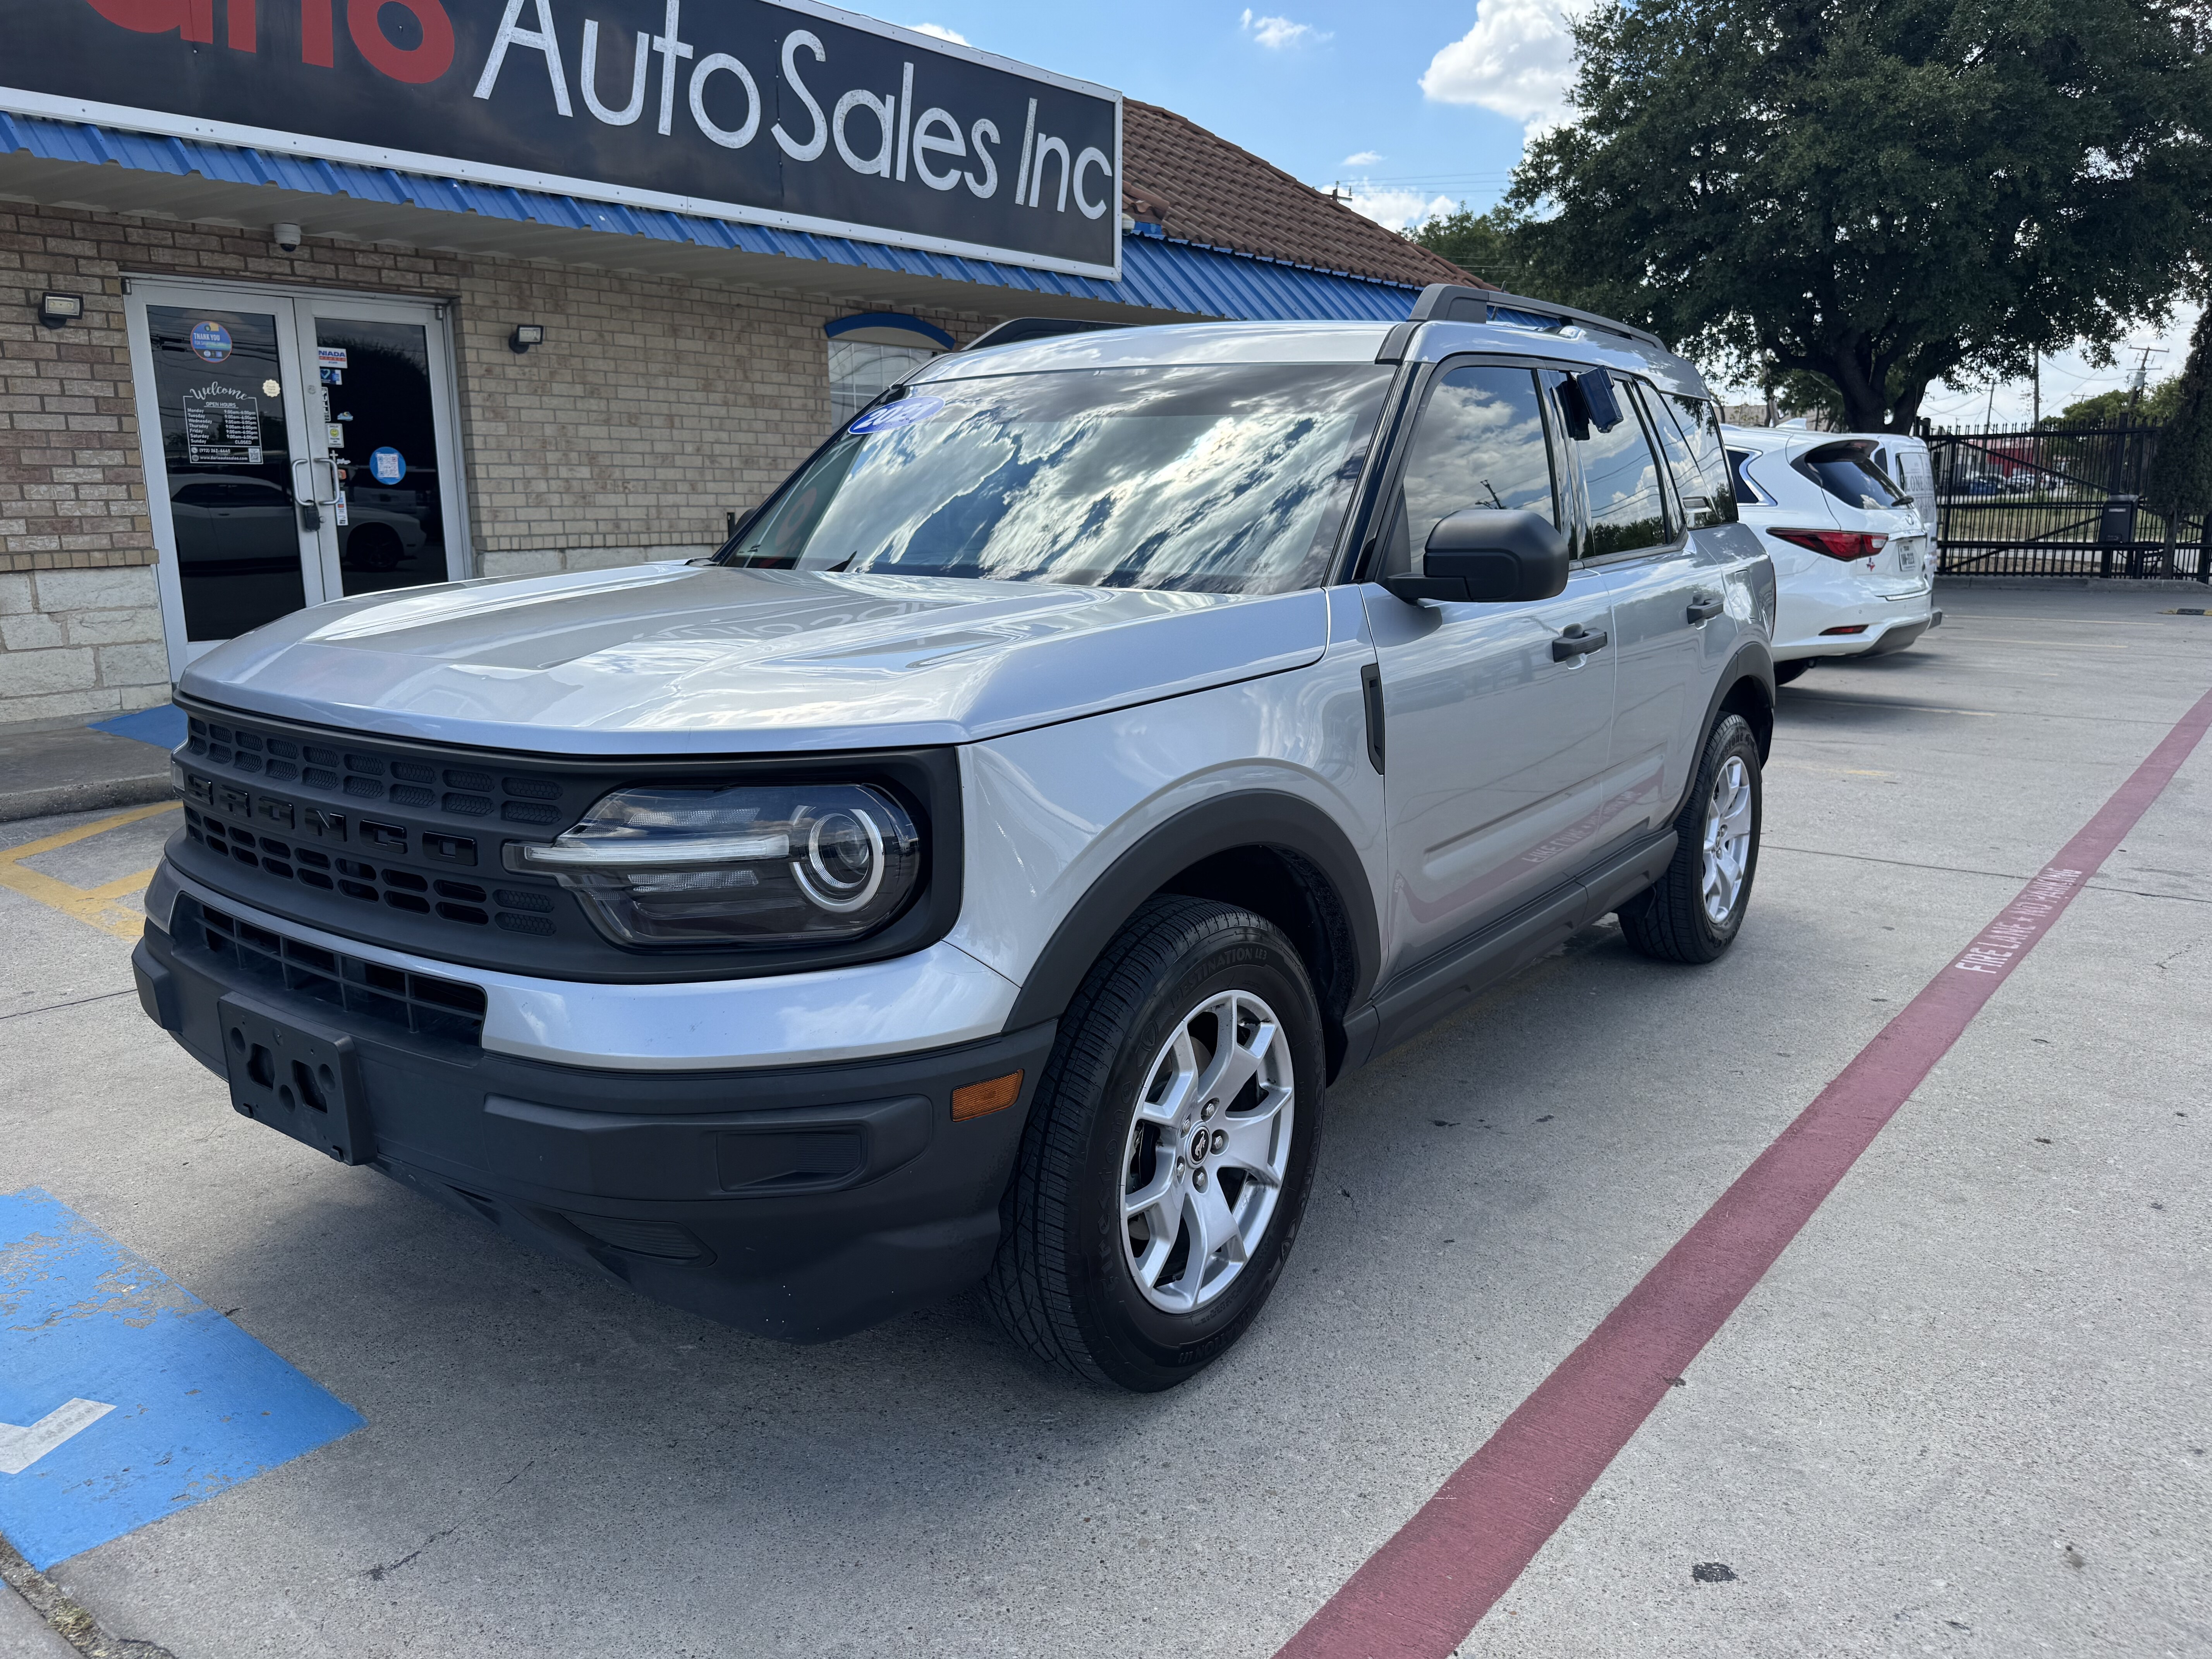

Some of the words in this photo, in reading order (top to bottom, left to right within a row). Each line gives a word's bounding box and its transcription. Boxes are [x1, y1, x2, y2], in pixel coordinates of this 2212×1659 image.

[1015, 97, 1113, 220] Inc
[190, 381, 249, 400] Welcome
[853, 400, 939, 430] 2021
[188, 773, 479, 866] BRONCO
[2020, 868, 2082, 903] PARKING
[2009, 902, 2052, 917] NO
[1977, 922, 2036, 949] LANE
[1955, 947, 2013, 974] FIRE
[1170, 948, 1252, 1008] DESTINATION
[1255, 948, 1267, 960] LE3
[1097, 1080, 1133, 1299] Firestone
